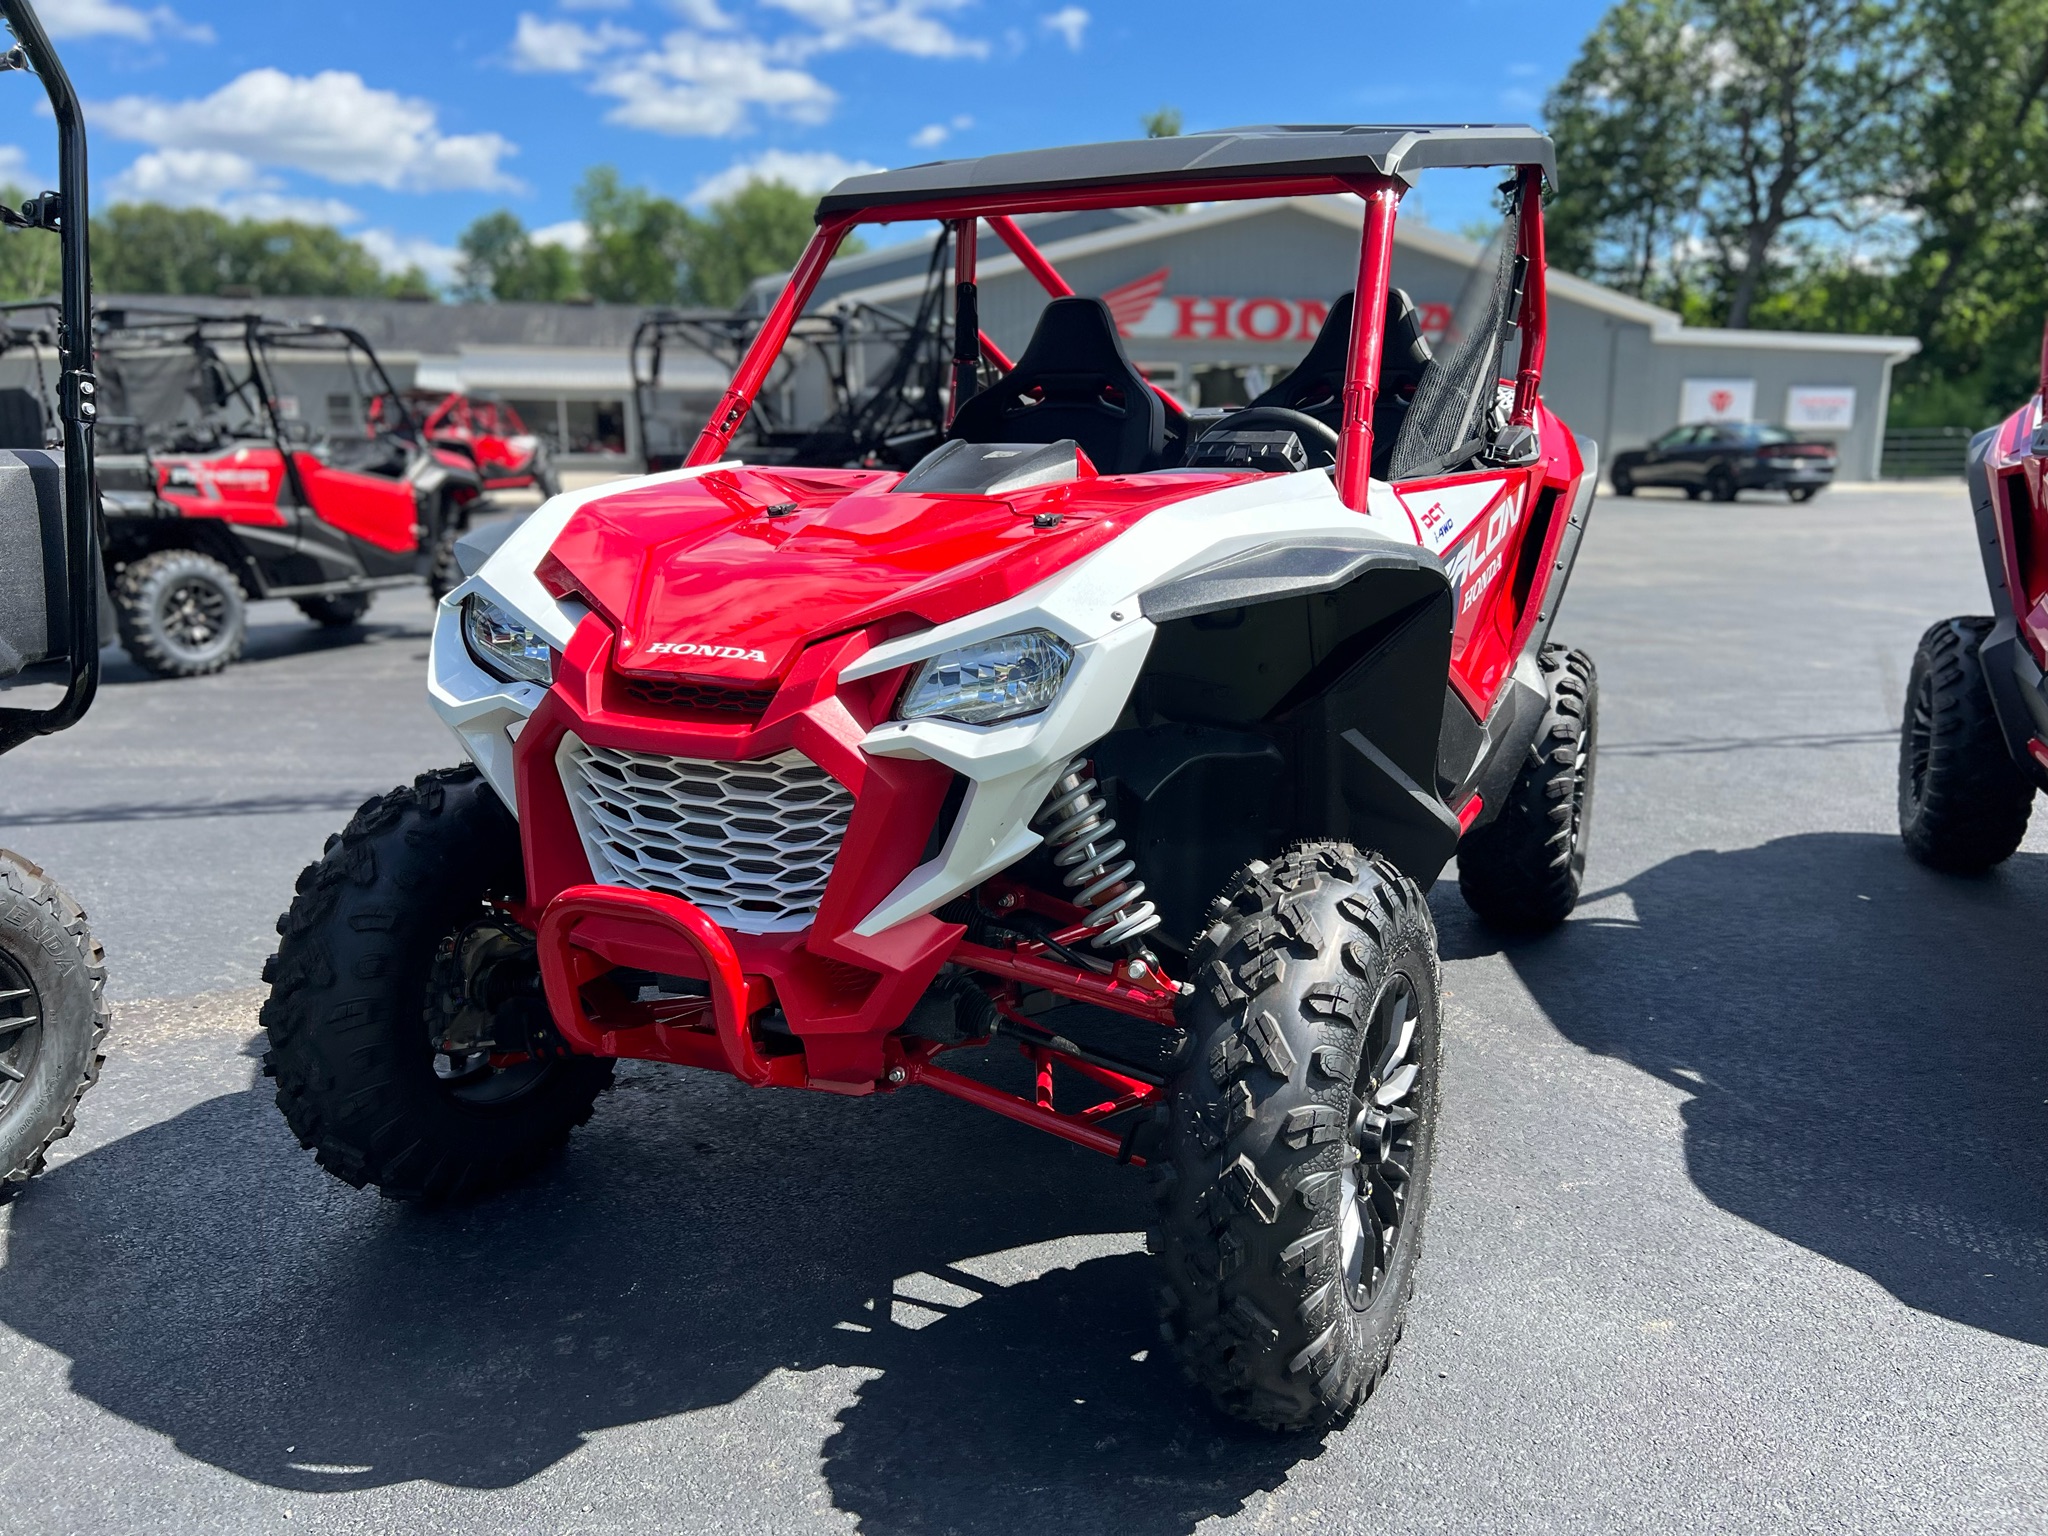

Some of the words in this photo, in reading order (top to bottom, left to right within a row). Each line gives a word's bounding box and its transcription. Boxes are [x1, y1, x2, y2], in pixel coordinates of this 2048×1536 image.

[1172, 295, 1461, 342] HONA
[1421, 501, 1445, 529] DCT
[1461, 551, 1503, 615] HONDA
[646, 642, 767, 663] HONDA
[0, 900, 78, 978] ENDA
